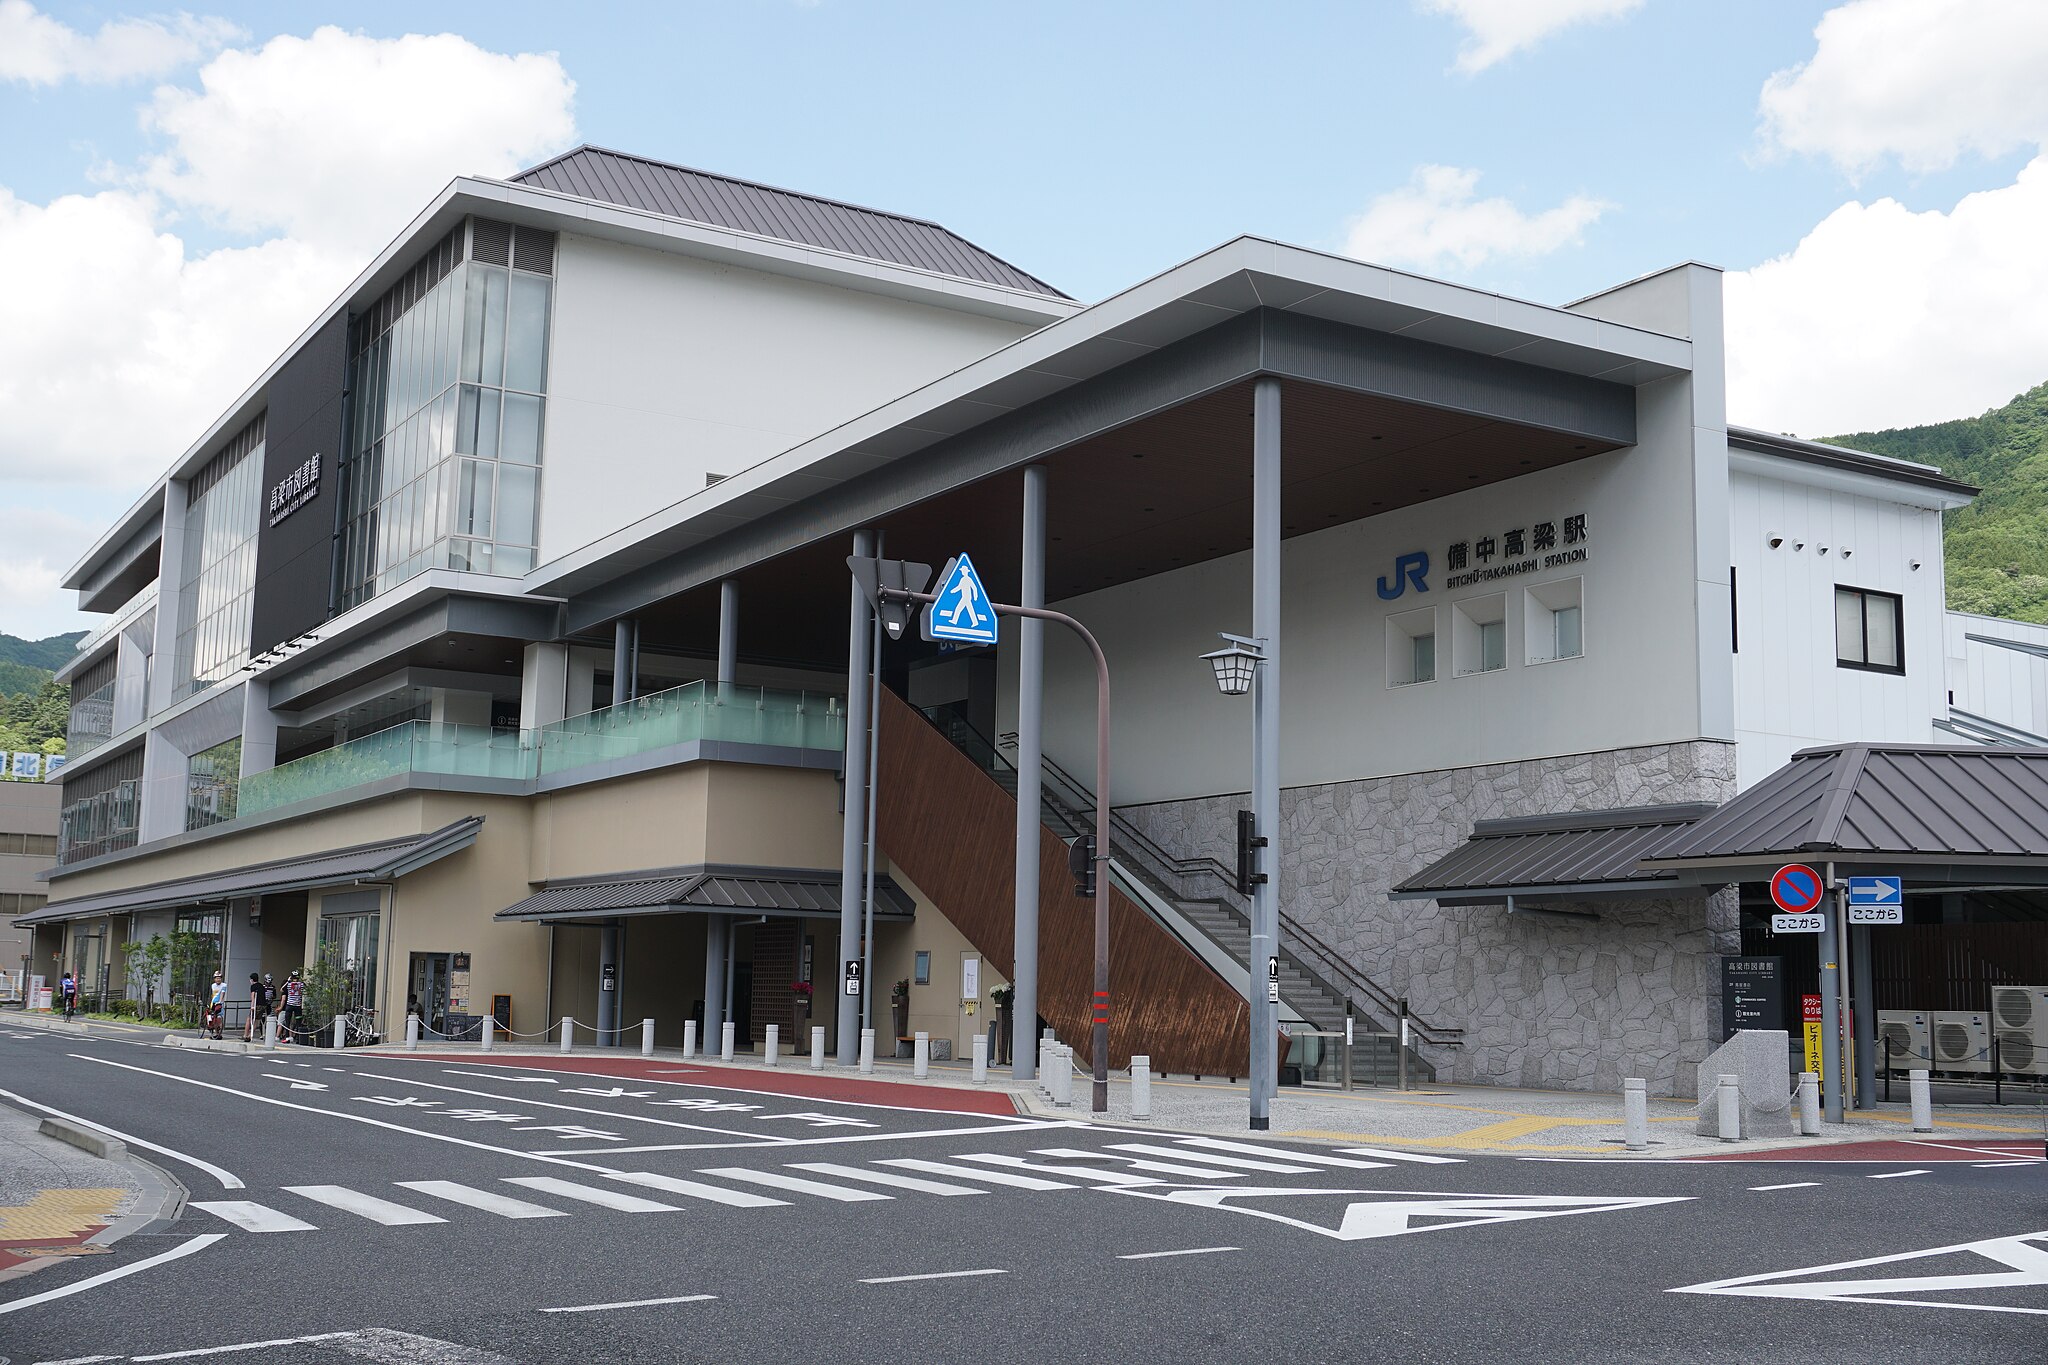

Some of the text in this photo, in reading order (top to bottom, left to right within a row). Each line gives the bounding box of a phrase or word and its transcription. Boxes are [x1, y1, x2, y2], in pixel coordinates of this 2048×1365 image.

[270, 452, 320, 513] 高梁市図書館
[1448, 513, 1588, 571] 備中高梁駅
[1544, 547, 1588, 568] STATION
[1377, 551, 1430, 601] JR
[1853, 909, 1898, 920] ここから
[1776, 918, 1821, 929] ここから
[1728, 962, 1774, 971] 高梁市図書館
[1804, 1006, 1821, 1015] のりば
